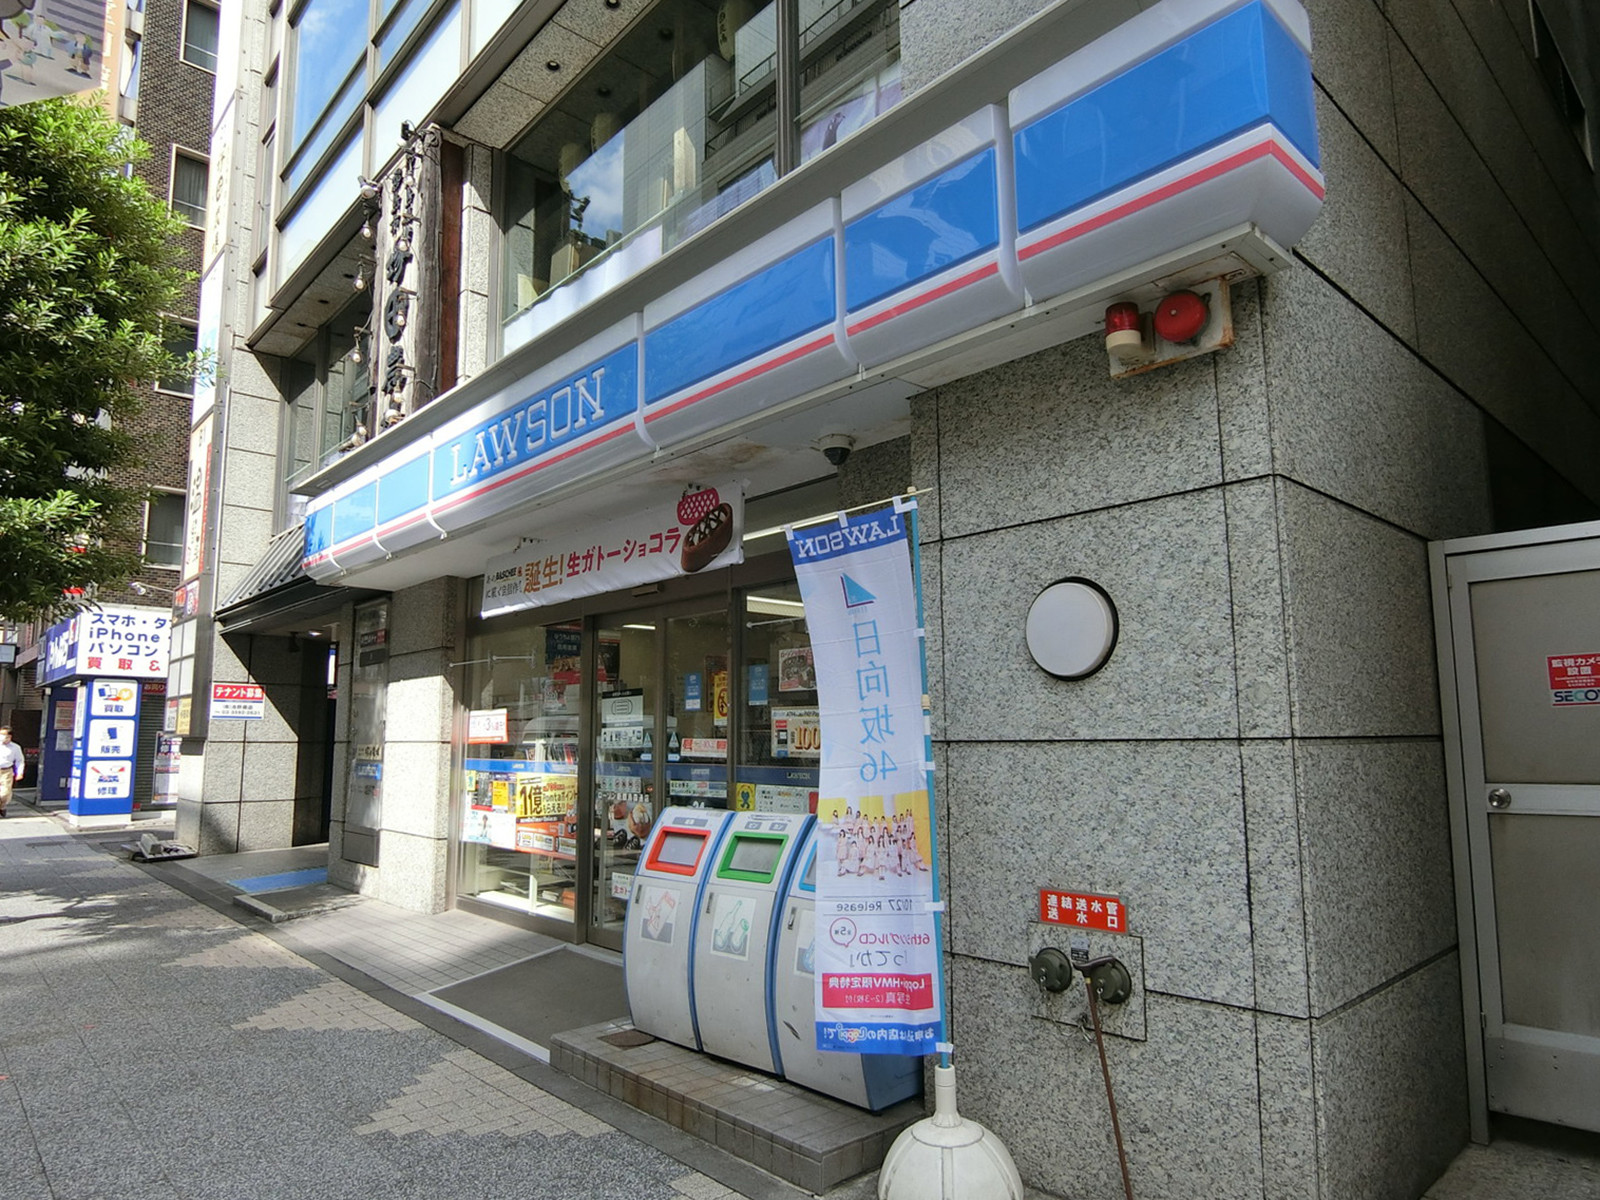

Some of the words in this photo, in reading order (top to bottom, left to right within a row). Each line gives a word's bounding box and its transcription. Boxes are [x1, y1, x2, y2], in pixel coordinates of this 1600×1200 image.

[450, 367, 605, 487] LAWSON
[91, 613, 173, 629] スマホ・タ
[89, 627, 160, 643] iPhone
[88, 642, 158, 657] パソコン
[215, 686, 263, 699] テナント募集
[1553, 689, 1600, 703] SECO
[103, 703, 125, 714] 買取
[100, 745, 121, 755] 販売
[97, 786, 118, 796] 修理
[1047, 894, 1118, 916] 連結送水管
[1047, 906, 1118, 929] 送水口
